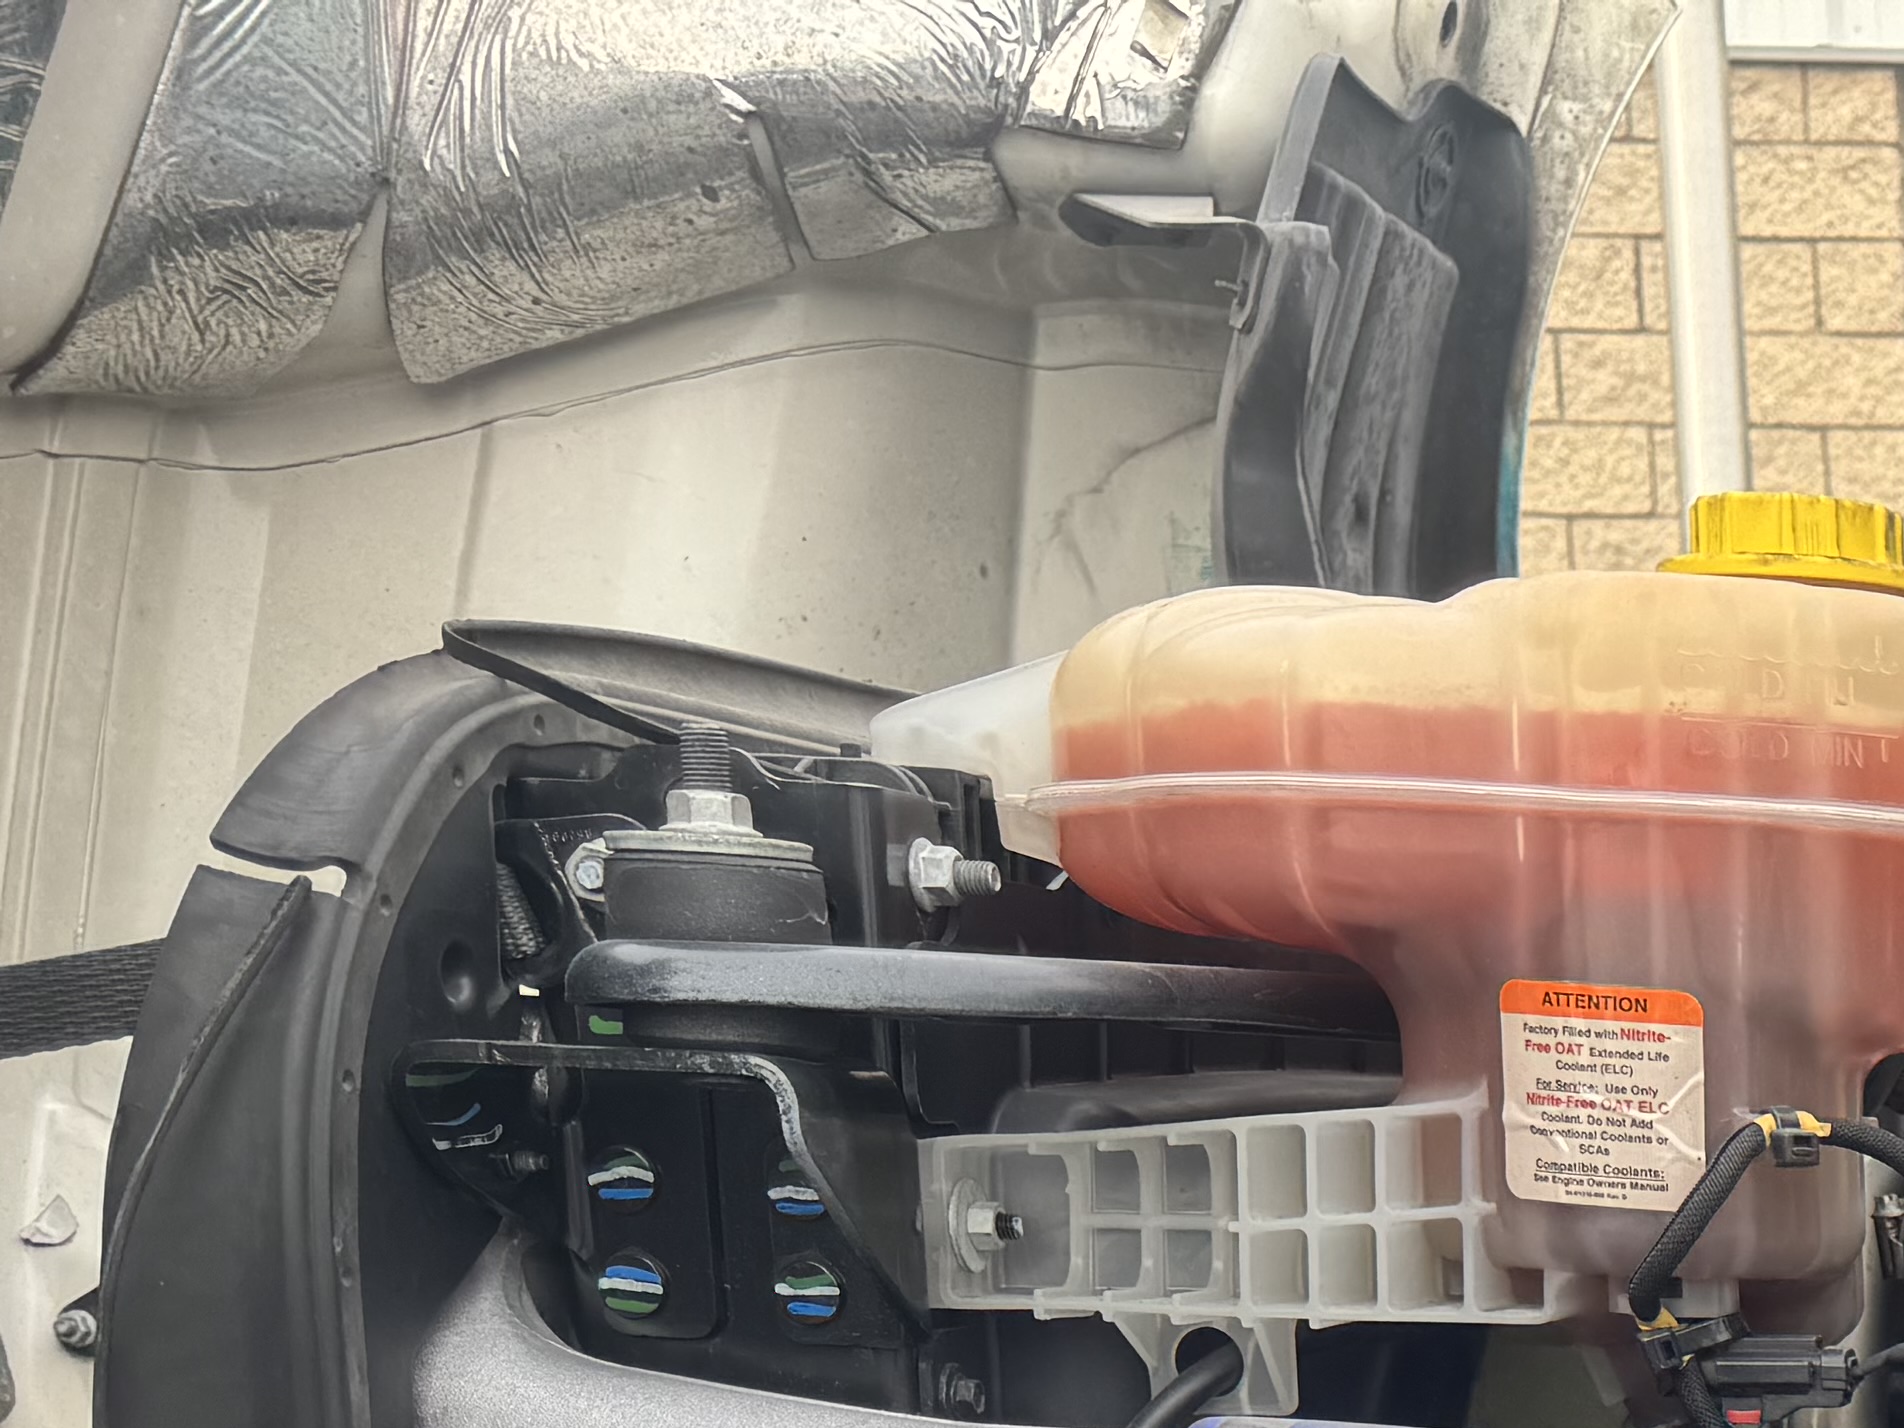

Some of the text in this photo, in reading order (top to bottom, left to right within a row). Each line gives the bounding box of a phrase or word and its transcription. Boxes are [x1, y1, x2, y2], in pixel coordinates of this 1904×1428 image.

[1542, 991, 1648, 1013] ATTENTION
[1523, 1023, 1671, 1043] Factory Filled with Nitrite-
[1525, 1039, 1670, 1062] Free OAT Extended Life
[1556, 1059, 1633, 1077] Coolant (ELC)
[1536, 1078, 1552, 1091] For
[1605, 1083, 1628, 1095] Use
[1631, 1084, 1659, 1099] Only
[1526, 1092, 1670, 1115] Nitrite-Free OAT ELC
[1587, 1114, 1603, 1126] Do
[1606, 1116, 1627, 1128] Not
[1630, 1118, 1653, 1130] Add
[1600, 1131, 1653, 1144] Coolants
[1656, 1136, 1669, 1146] or
[1579, 1145, 1610, 1156] SCAs
[1536, 1158, 1665, 1180] Compatible Coolants:
[1552, 1175, 1585, 1188] Engine
[1587, 1179, 1627, 1190] Owners
[1630, 1182, 1669, 1192] Manual
